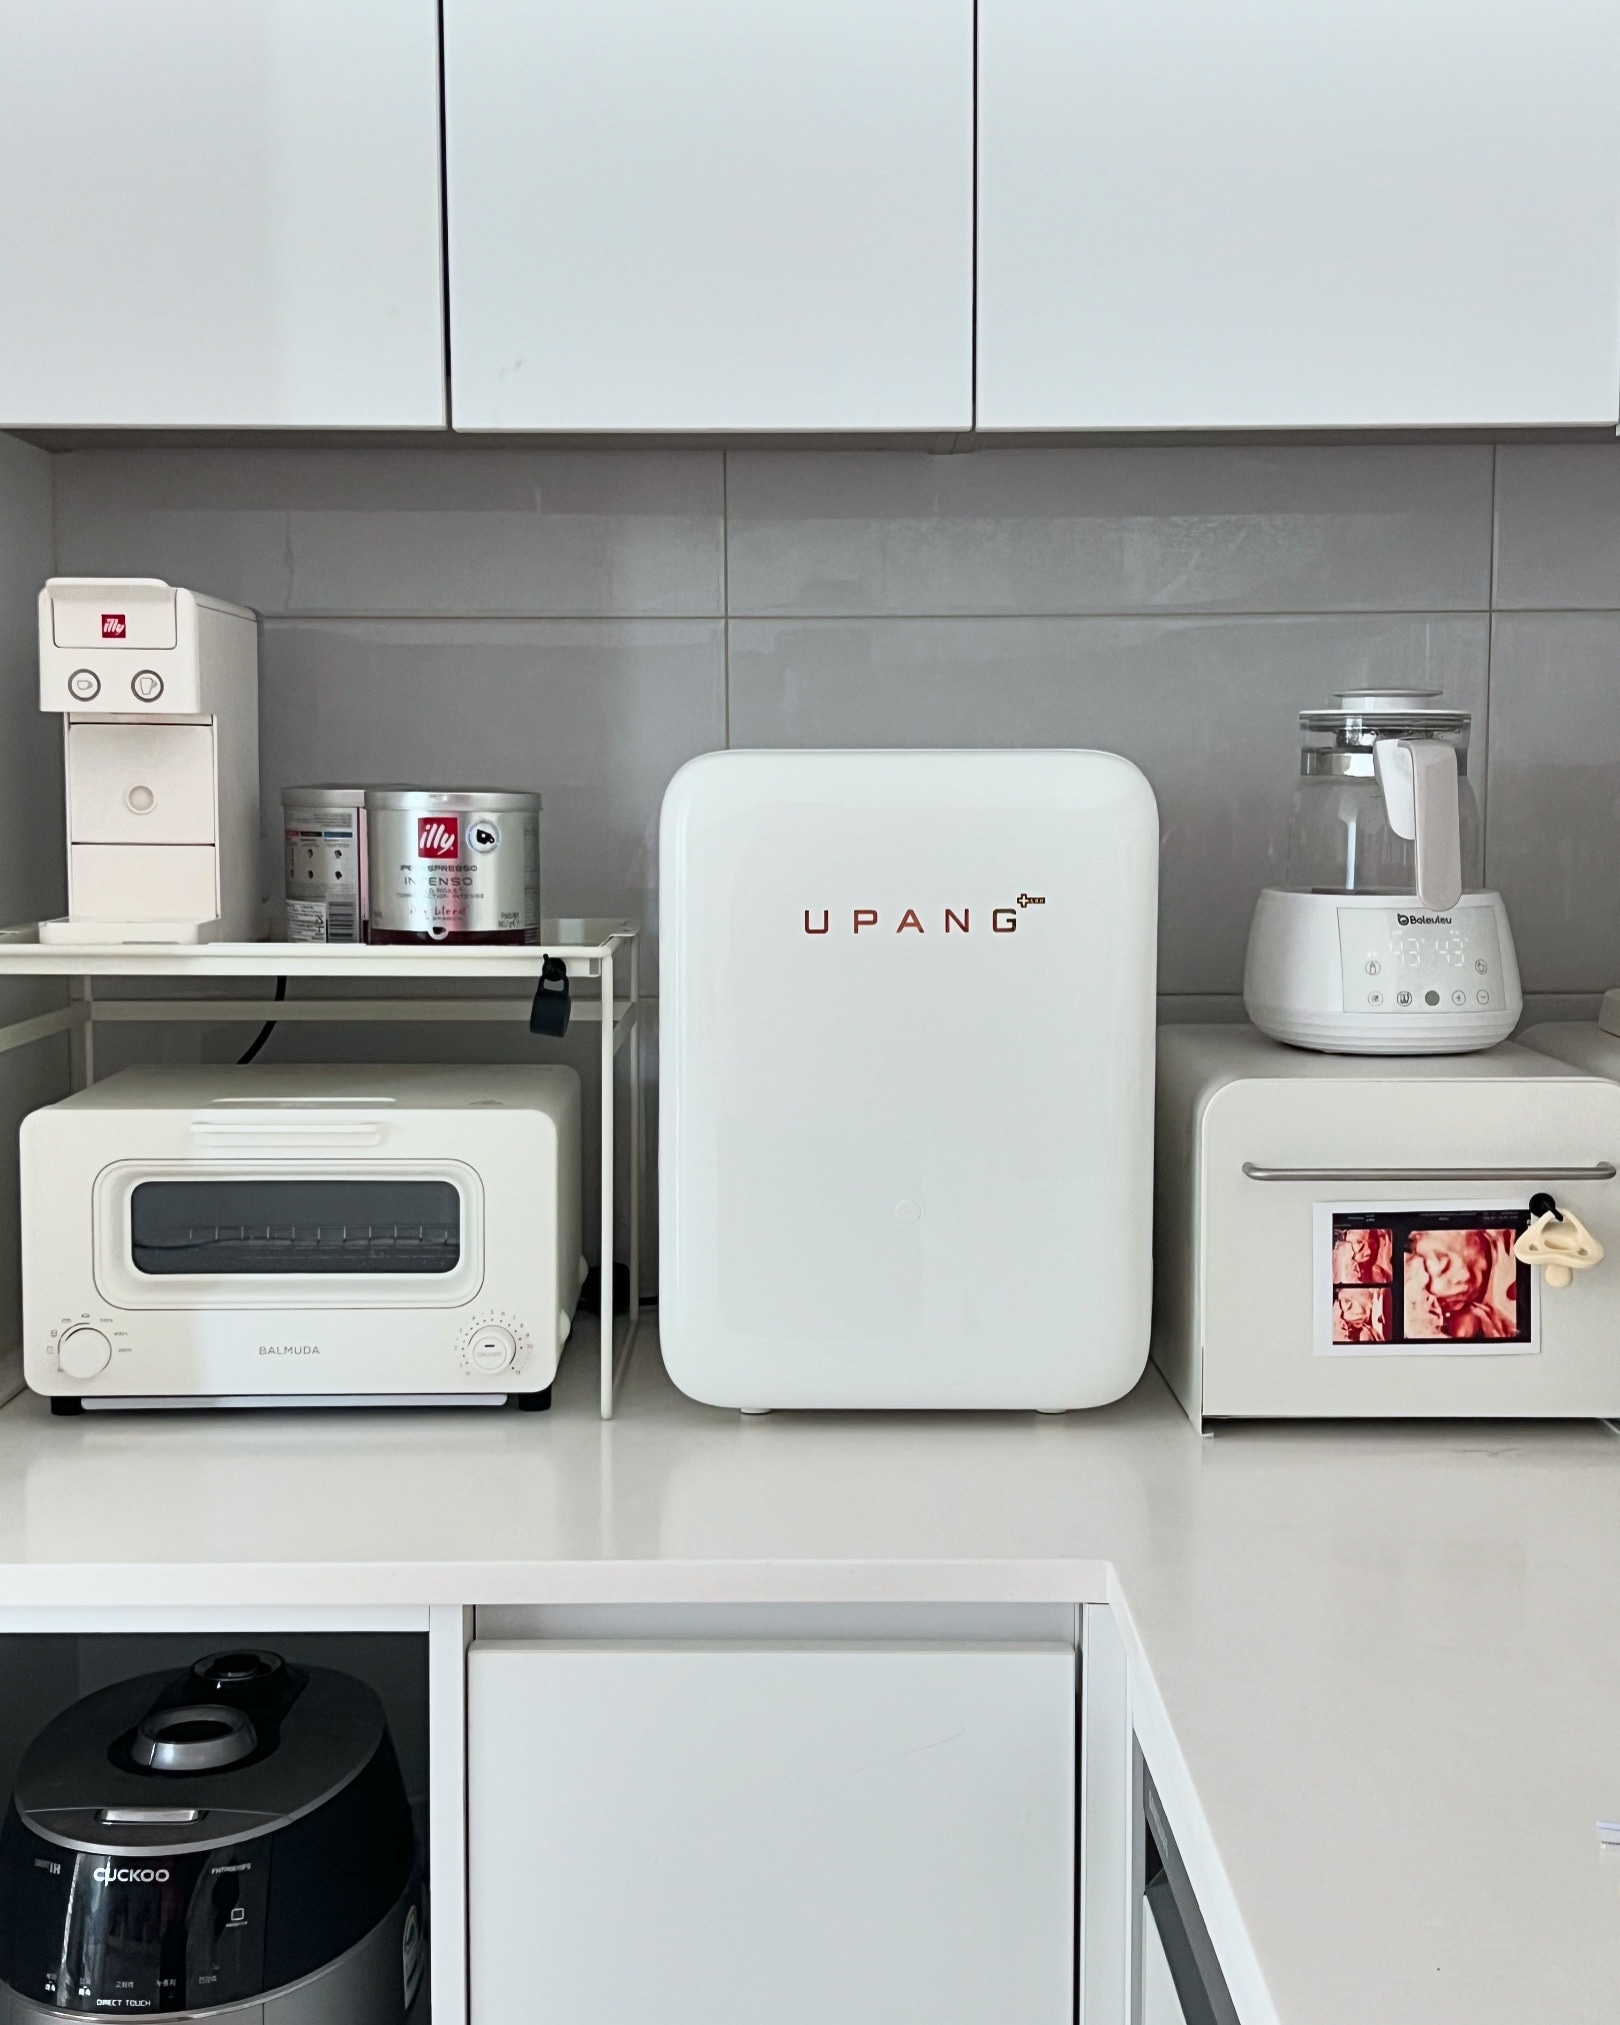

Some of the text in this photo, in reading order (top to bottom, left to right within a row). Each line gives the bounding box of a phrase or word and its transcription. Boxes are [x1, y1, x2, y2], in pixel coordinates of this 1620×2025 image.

[103, 618, 125, 636] illy
[419, 823, 456, 856] illy
[404, 876, 473, 887] INENSO
[804, 908, 1017, 934] UPANG
[259, 1346, 320, 1355] BALMUDA
[93, 1867, 170, 1884] CUCKOO
